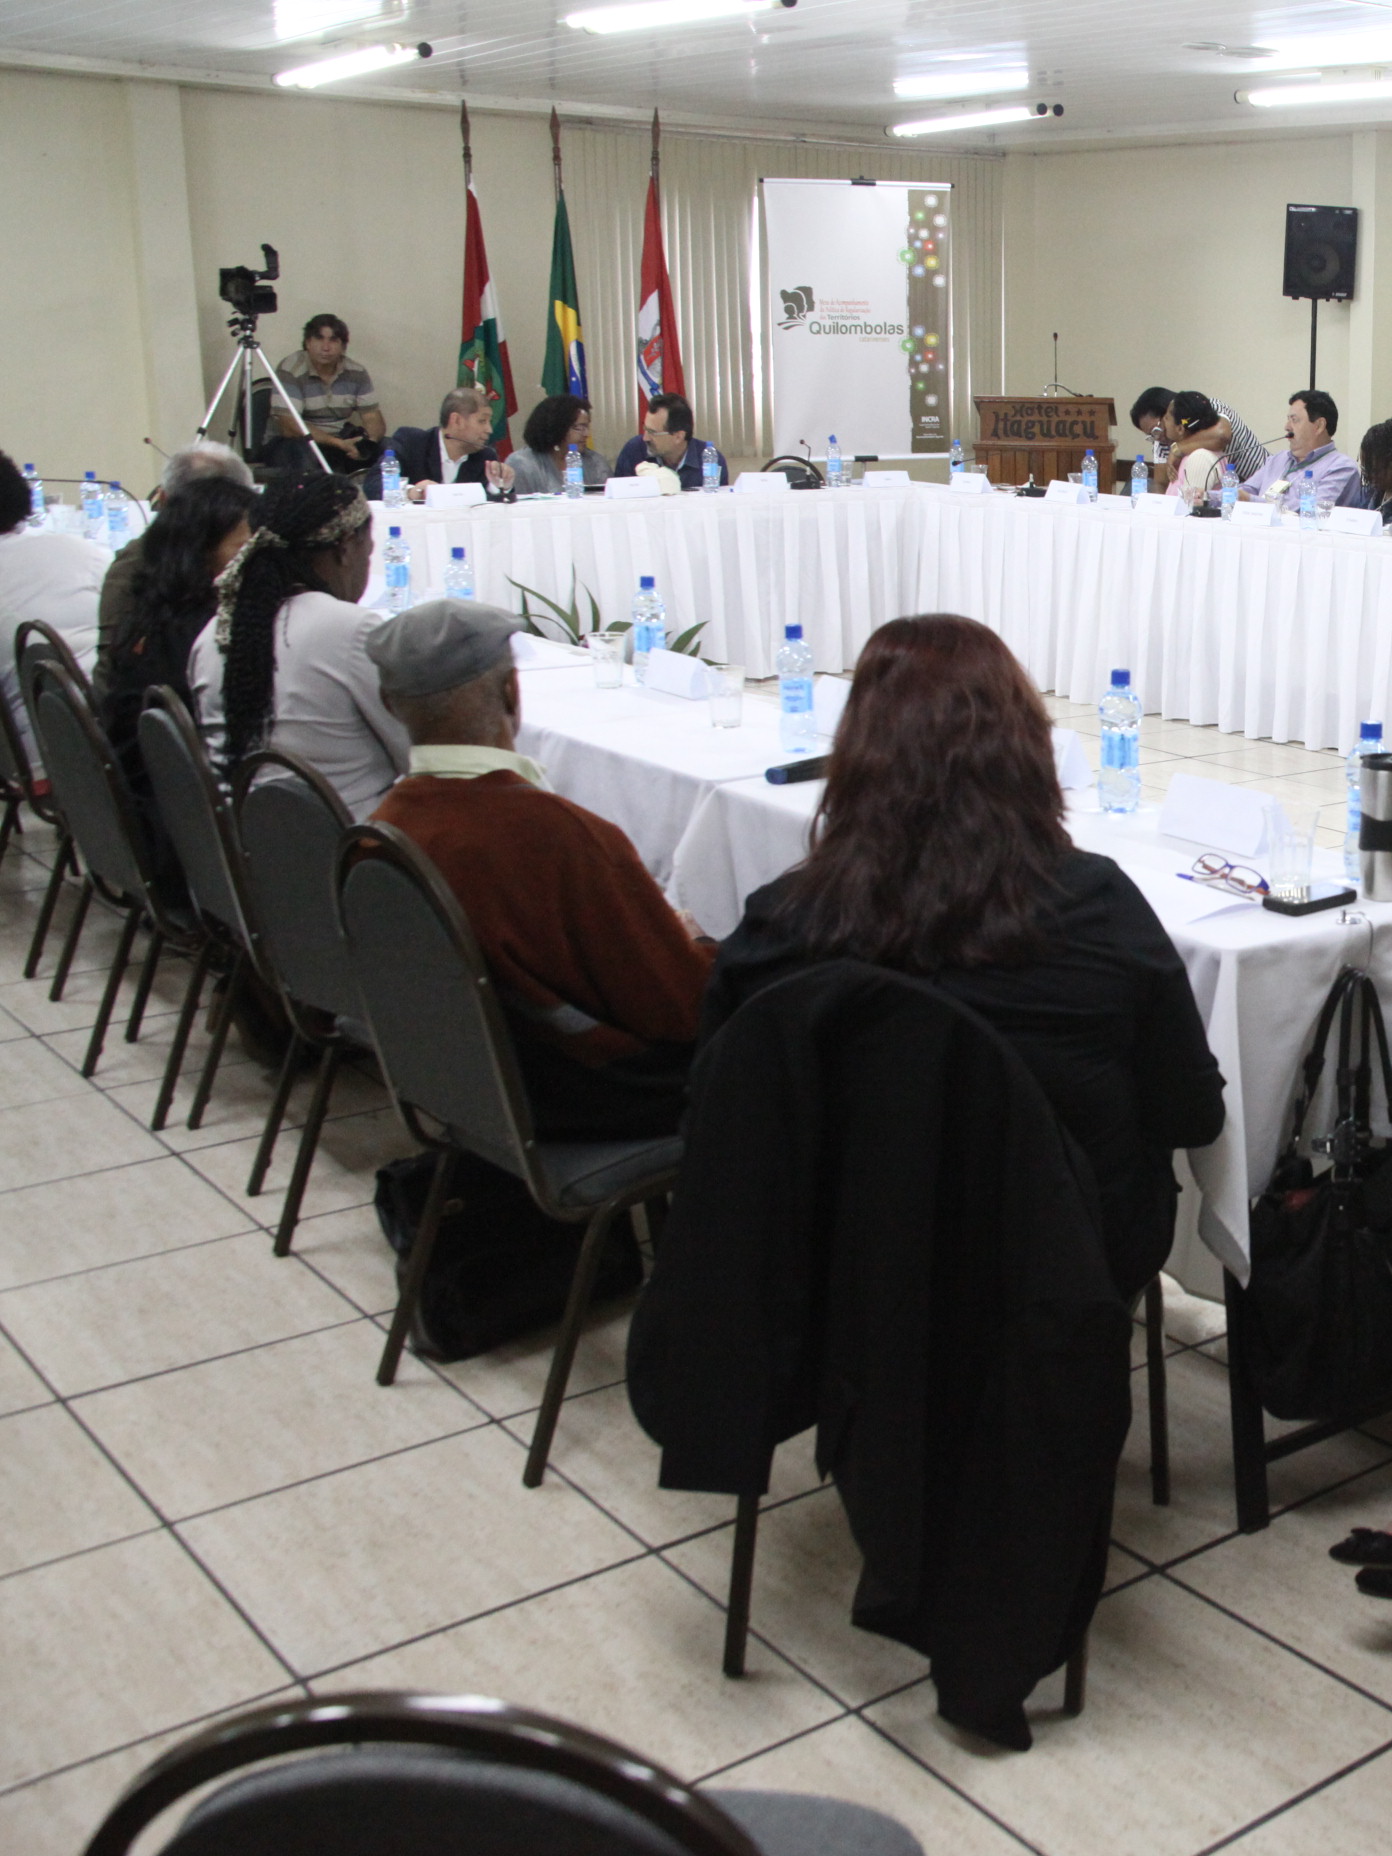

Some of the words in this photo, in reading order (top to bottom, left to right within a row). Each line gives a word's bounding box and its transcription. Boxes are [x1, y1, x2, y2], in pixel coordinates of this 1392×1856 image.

[809, 321, 904, 335] Quilombolas
[1012, 404, 1060, 418] Hotel
[991, 411, 1099, 440] Itaguaçu
